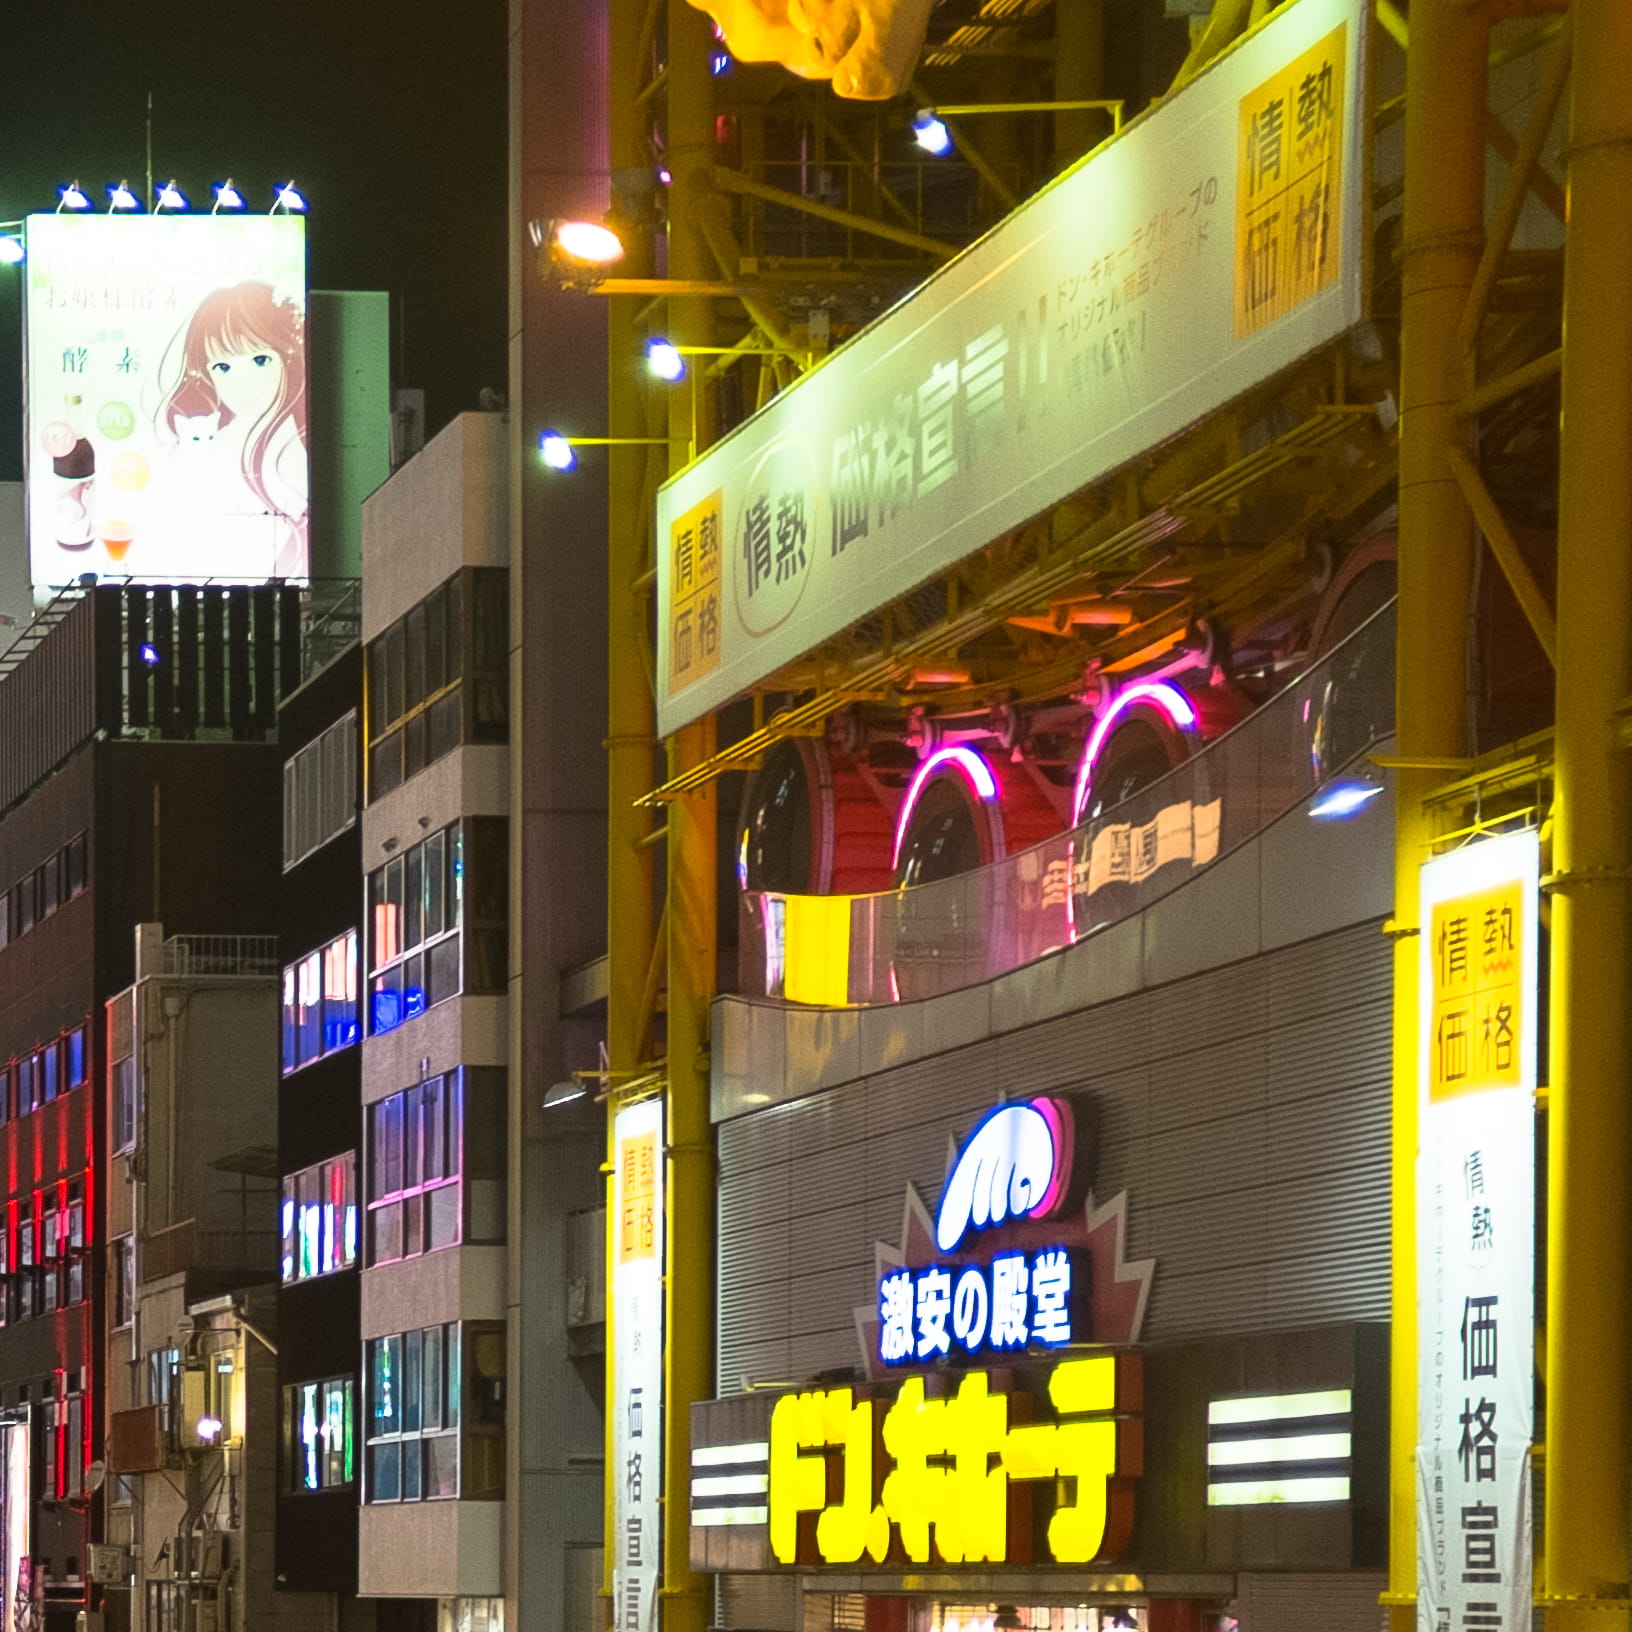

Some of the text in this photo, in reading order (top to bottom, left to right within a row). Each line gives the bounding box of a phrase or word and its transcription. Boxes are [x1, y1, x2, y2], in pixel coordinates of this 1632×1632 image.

[880, 1250, 1071, 1362] 激安の殿堂
